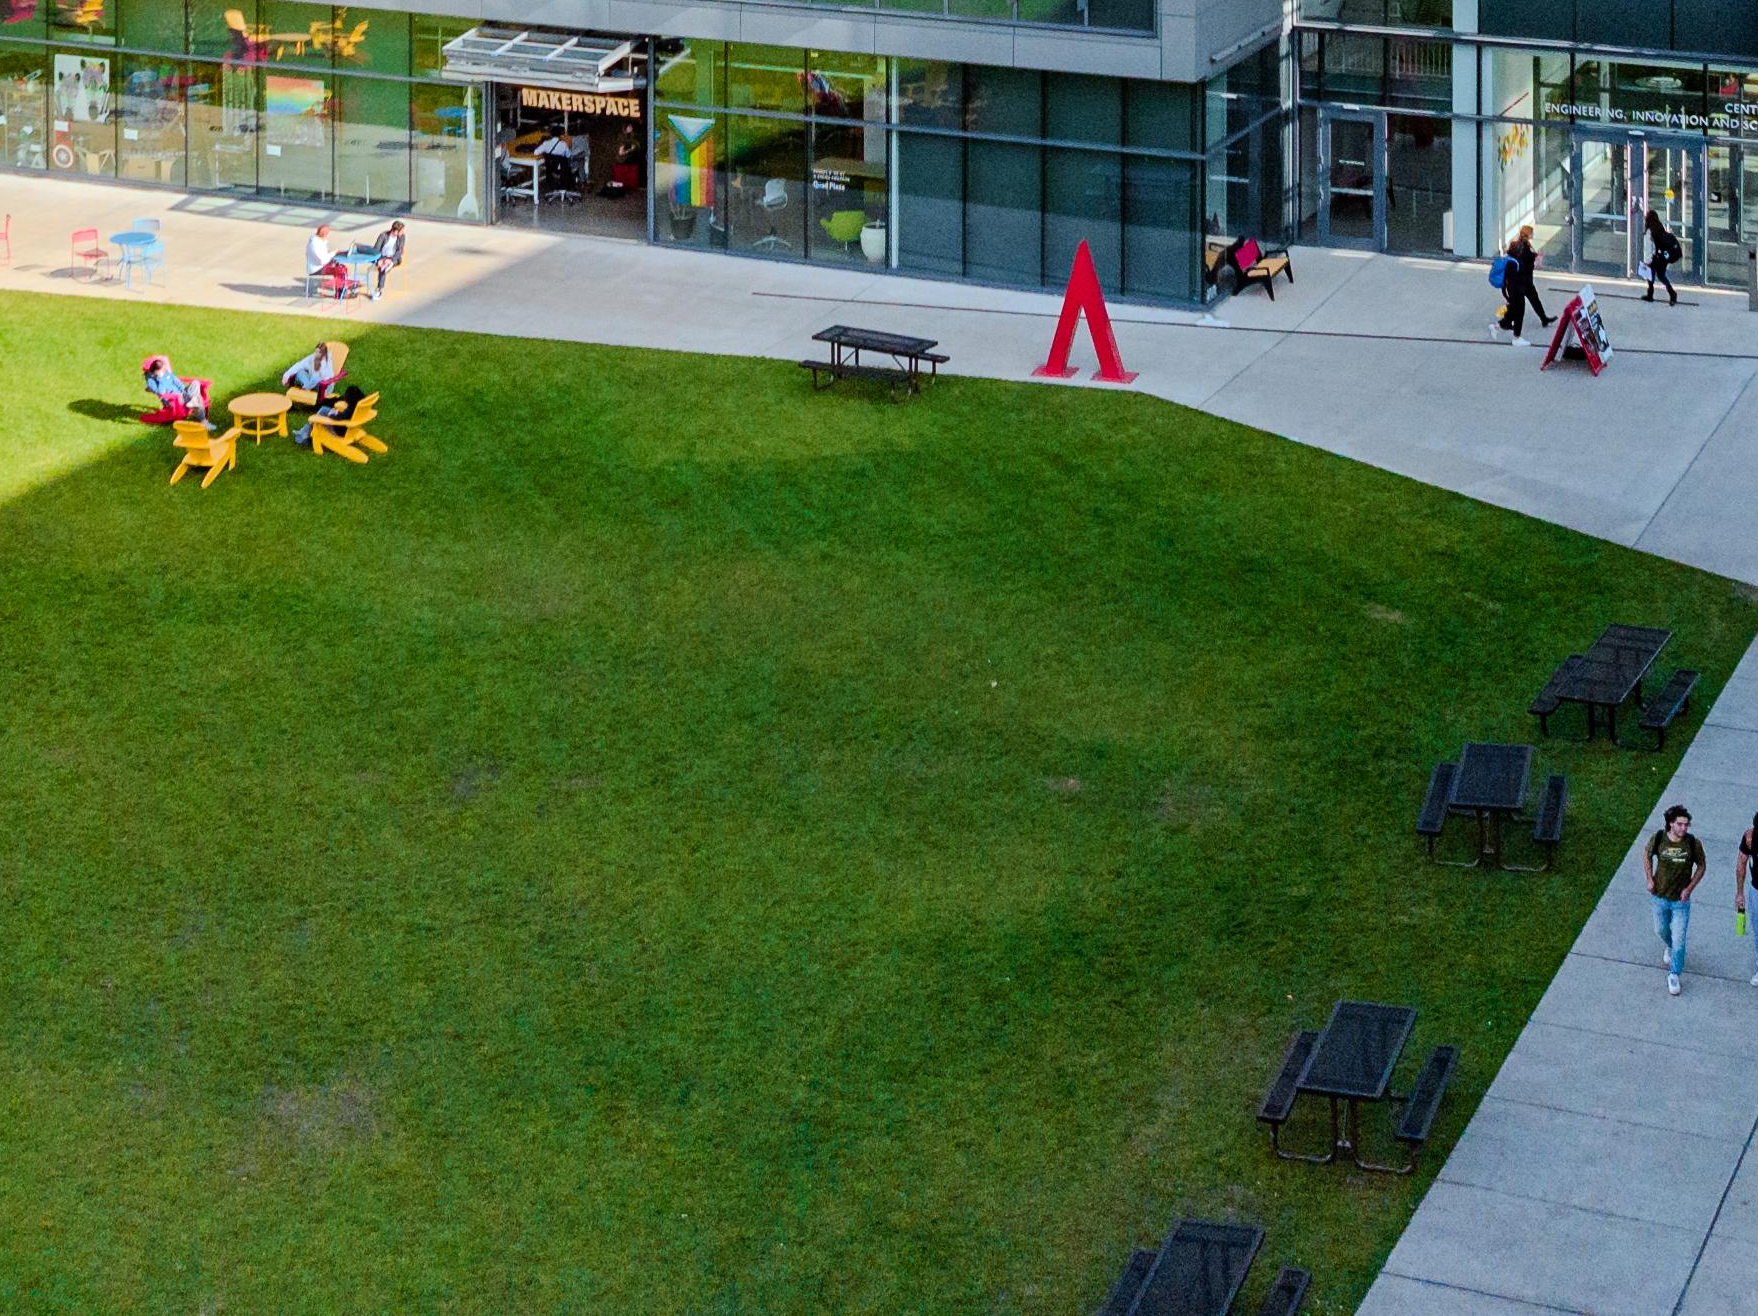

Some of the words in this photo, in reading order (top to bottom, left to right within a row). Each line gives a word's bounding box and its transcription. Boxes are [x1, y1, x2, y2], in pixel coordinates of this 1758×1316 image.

[521, 87, 641, 118] MAKERSPACE
[1632, 110, 1709, 126] INNOVATION
[1712, 117, 1740, 129] AND
